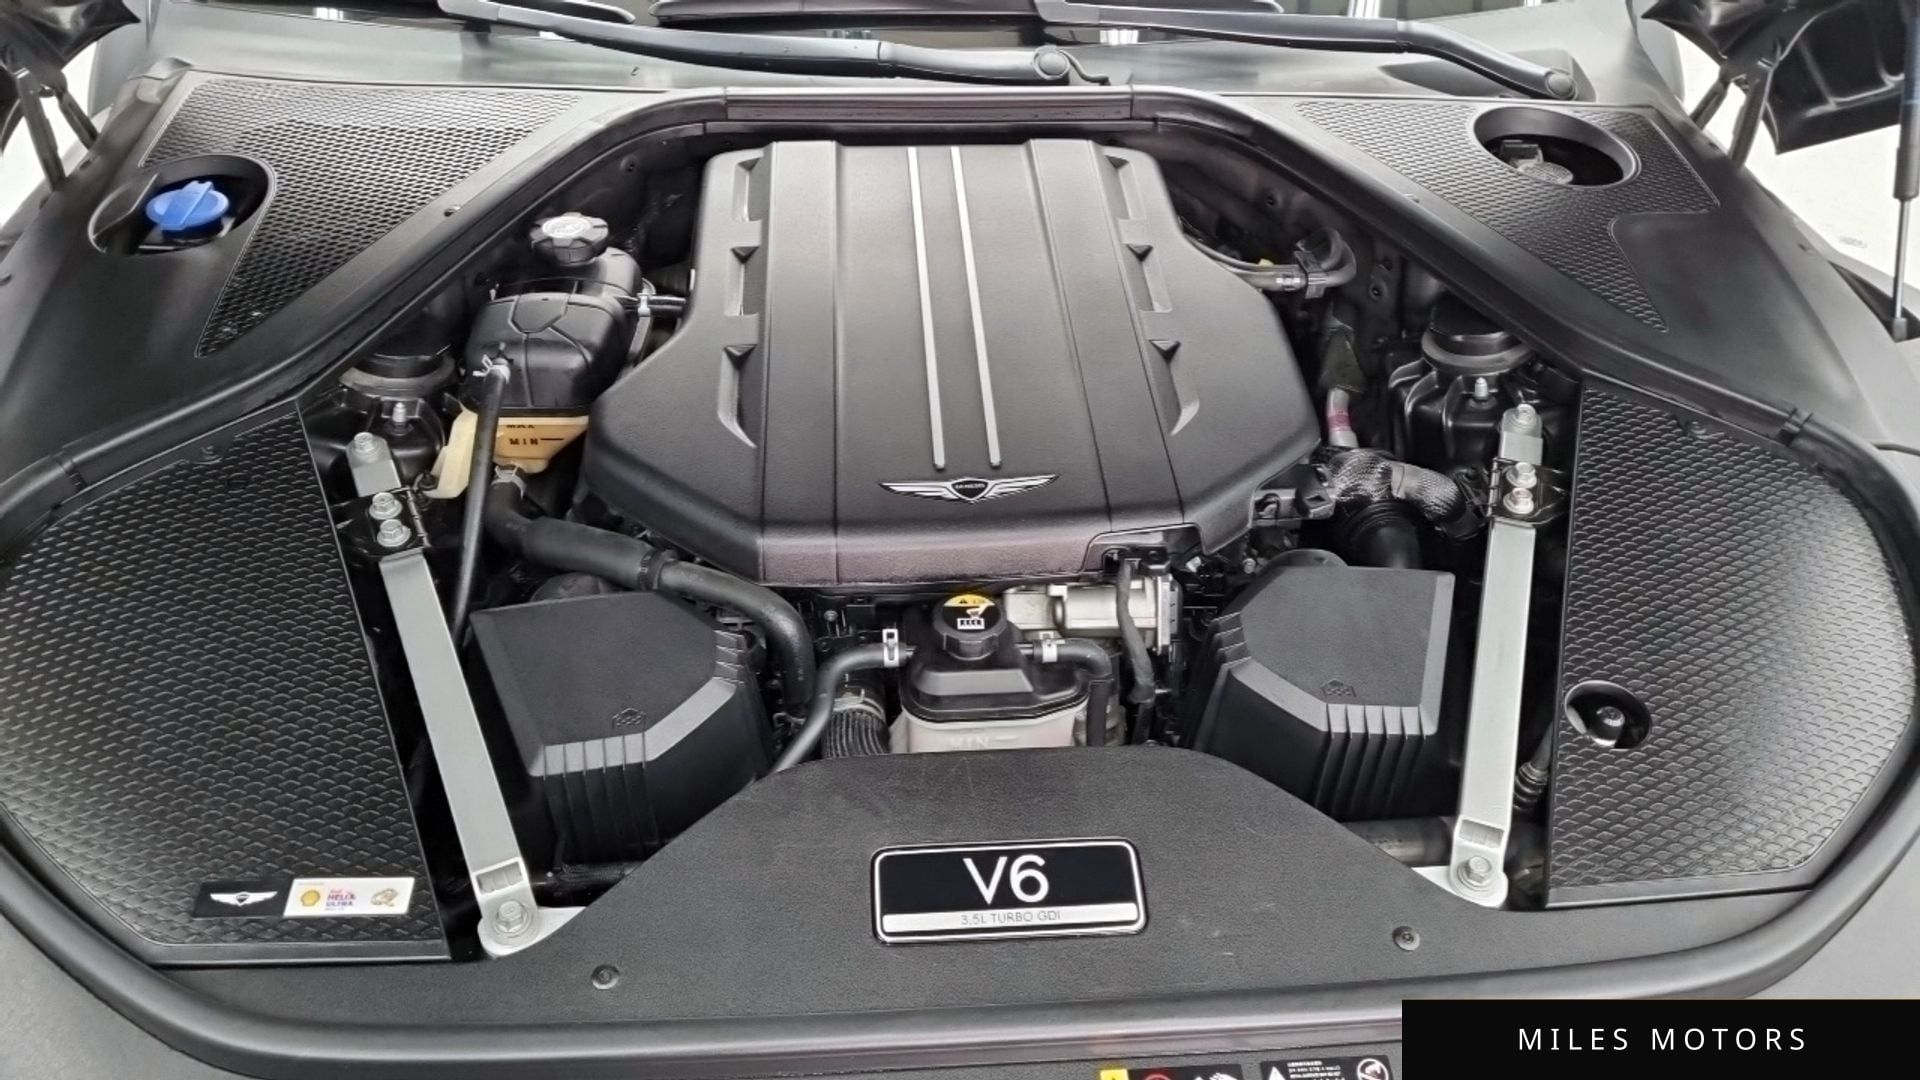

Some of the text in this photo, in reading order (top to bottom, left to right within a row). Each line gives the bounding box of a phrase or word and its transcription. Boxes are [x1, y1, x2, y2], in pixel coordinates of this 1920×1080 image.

[508, 437, 539, 446] MIN
[962, 854, 1049, 905] V6
[961, 910, 1060, 926] 3.5L TURBO GDI
